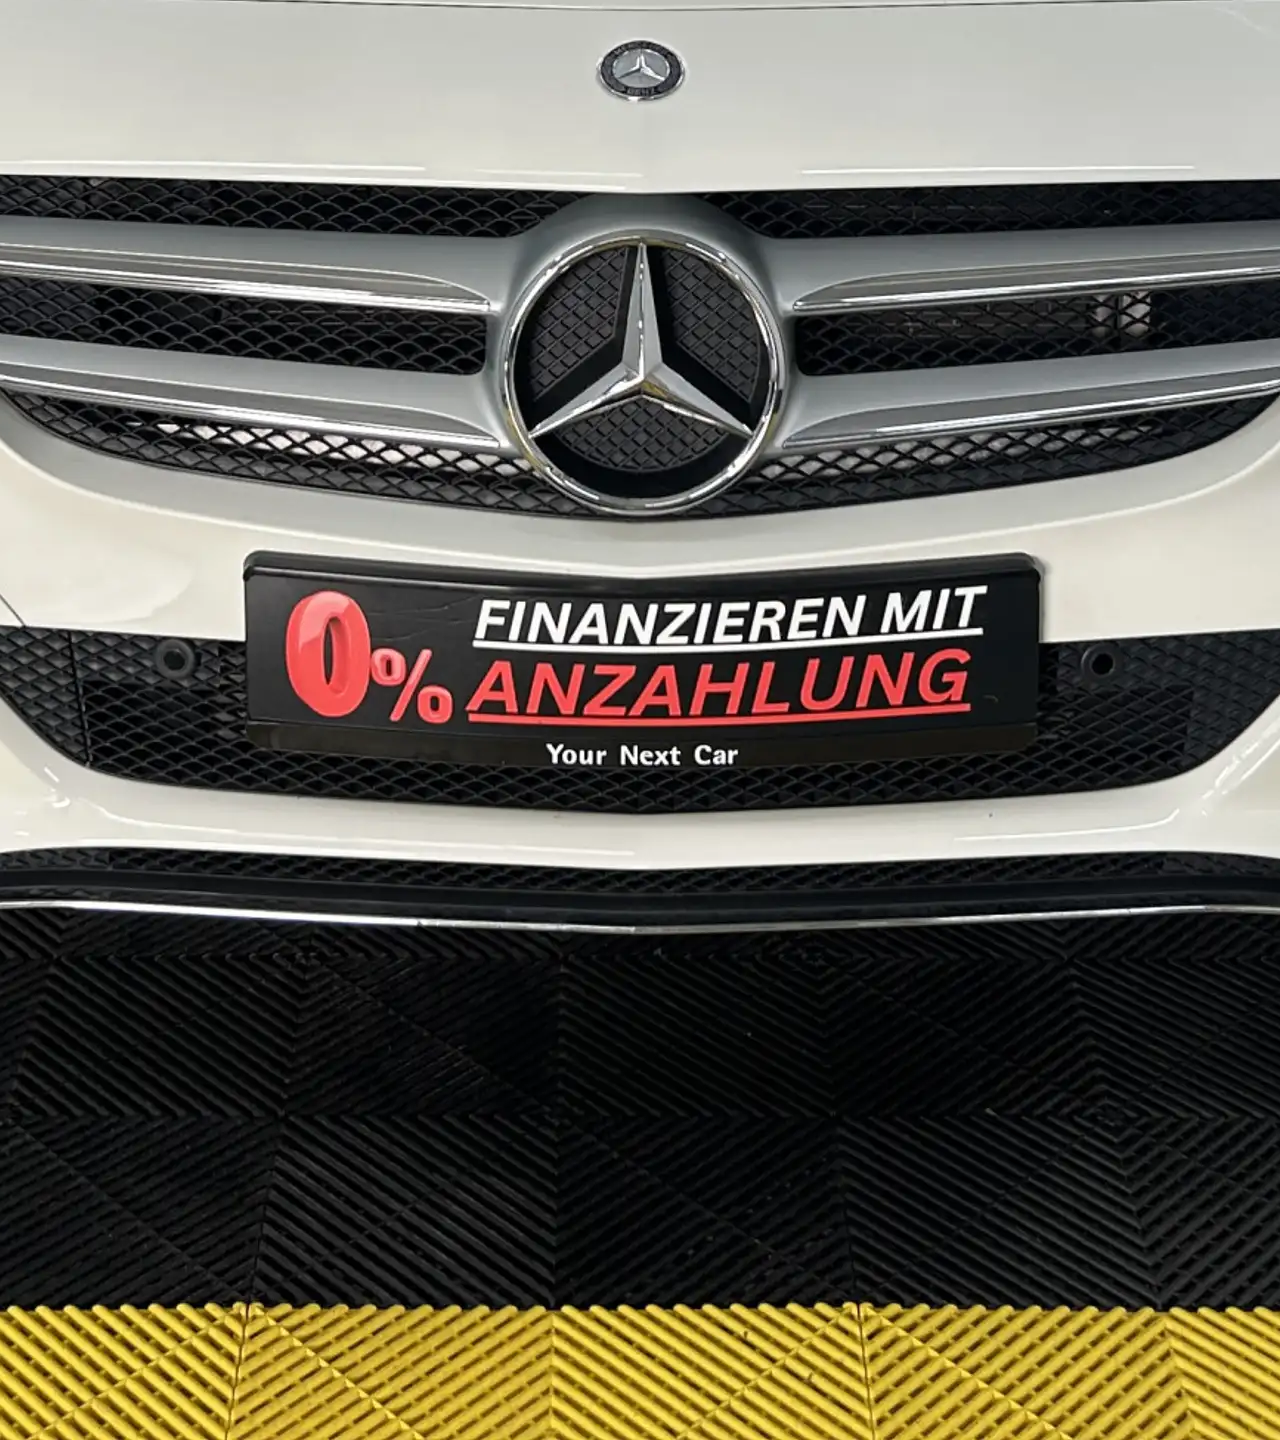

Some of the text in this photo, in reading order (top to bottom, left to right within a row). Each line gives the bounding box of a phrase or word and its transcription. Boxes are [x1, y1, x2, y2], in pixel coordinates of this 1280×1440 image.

[475, 585, 988, 645] FINANZIEREN MIT
[285, 590, 971, 724] 0% ANZAHLUNG
[545, 743, 739, 766] Your Next Car
